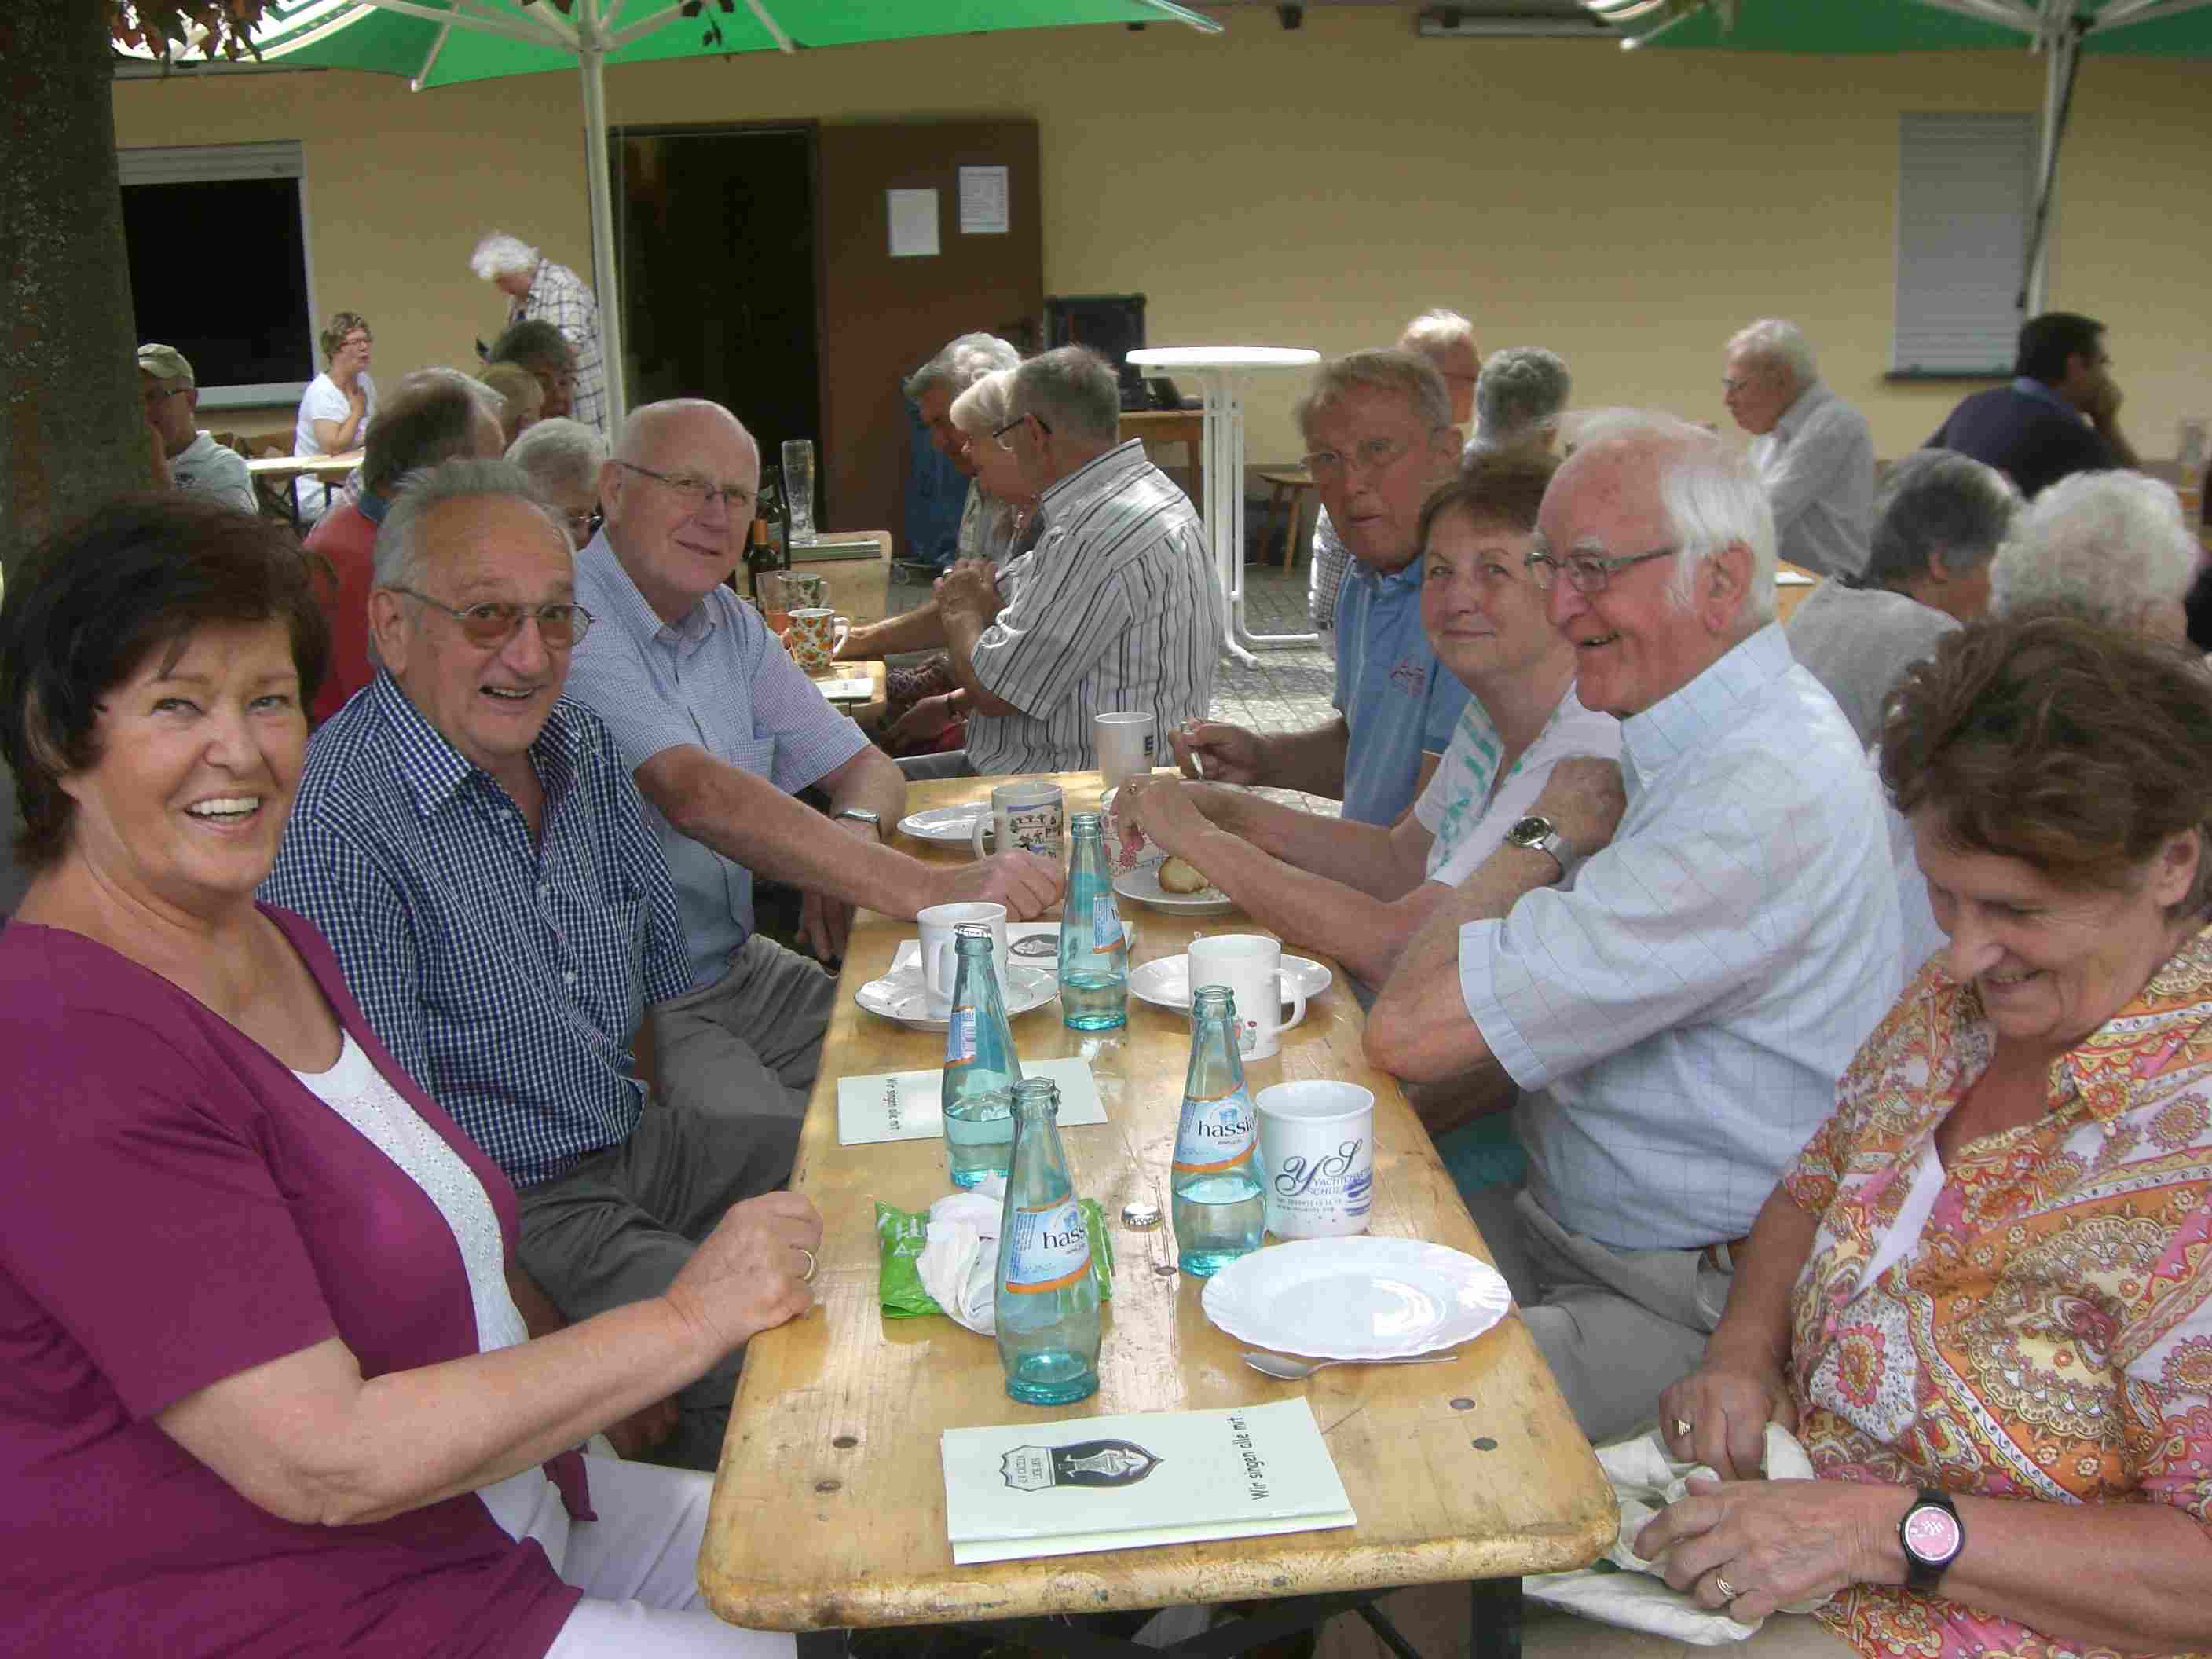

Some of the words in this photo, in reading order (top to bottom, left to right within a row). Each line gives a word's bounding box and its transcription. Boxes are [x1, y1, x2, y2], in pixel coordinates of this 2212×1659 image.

[1231, 1434, 1253, 1449] alle
[1242, 1451, 1265, 1479] singen
[1248, 1482, 1270, 1501] Wir
